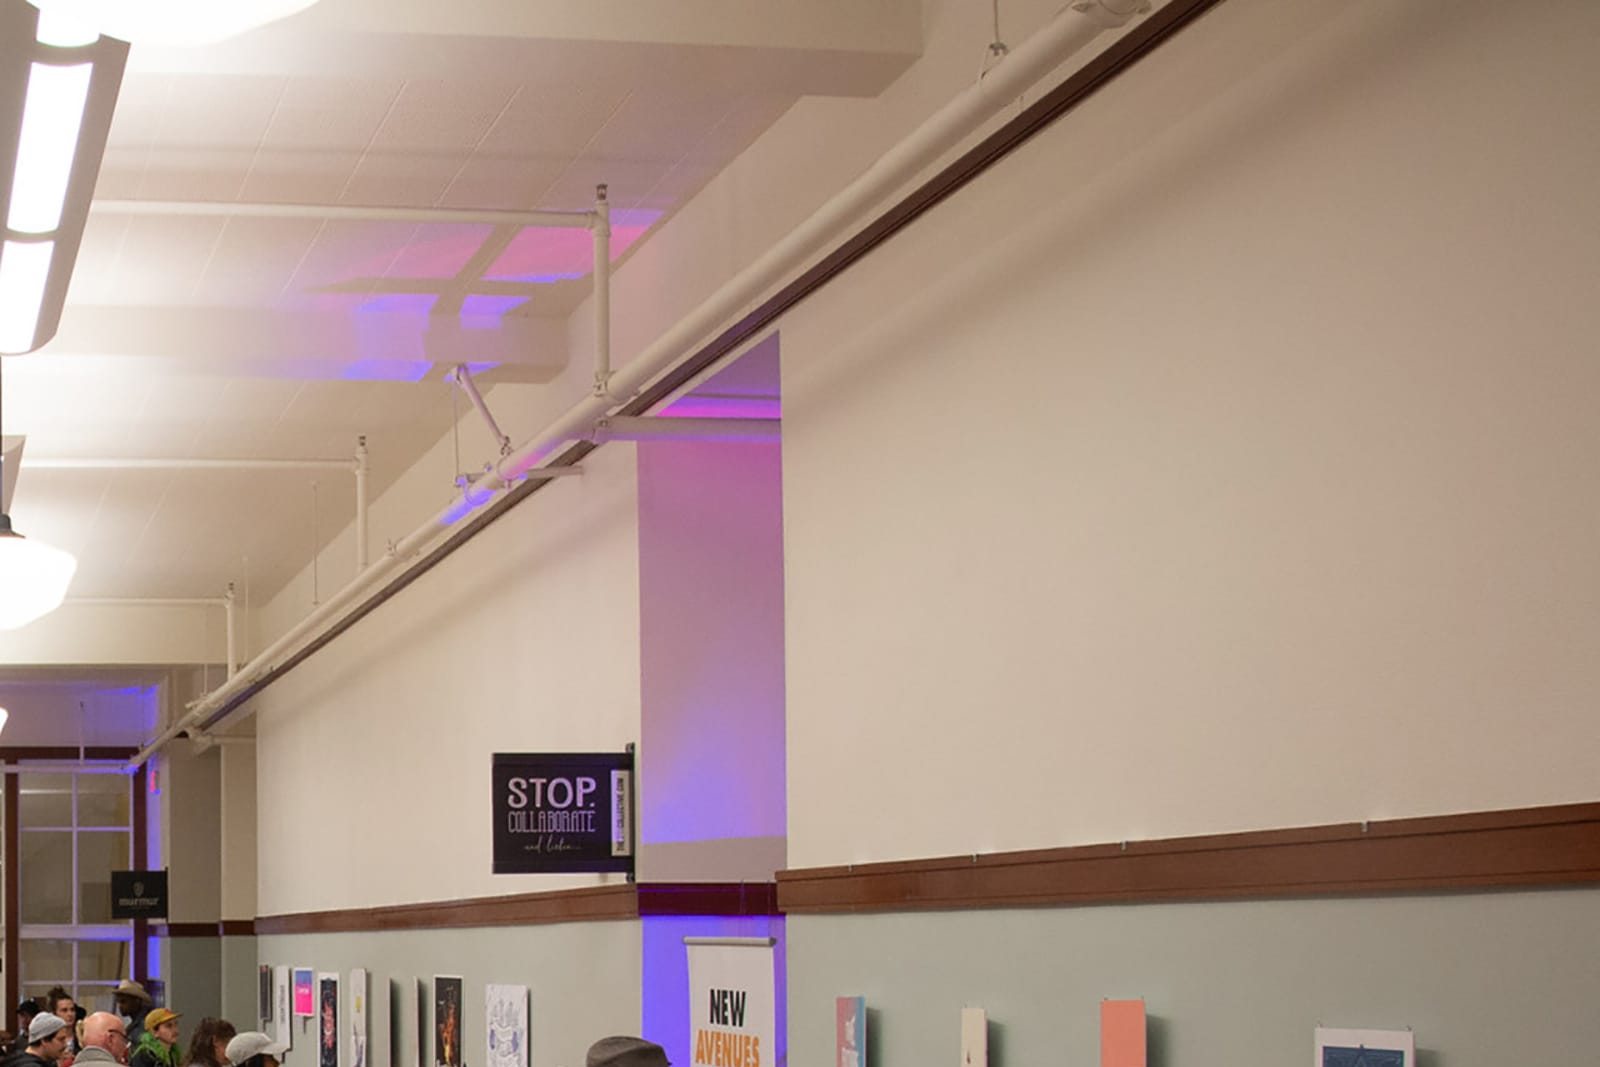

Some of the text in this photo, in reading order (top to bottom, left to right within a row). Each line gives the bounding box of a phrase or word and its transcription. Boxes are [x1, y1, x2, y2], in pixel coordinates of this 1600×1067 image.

[507, 777, 596, 808] STOP.
[508, 810, 596, 833] COLLABORATE
[709, 989, 746, 1027] NEW
